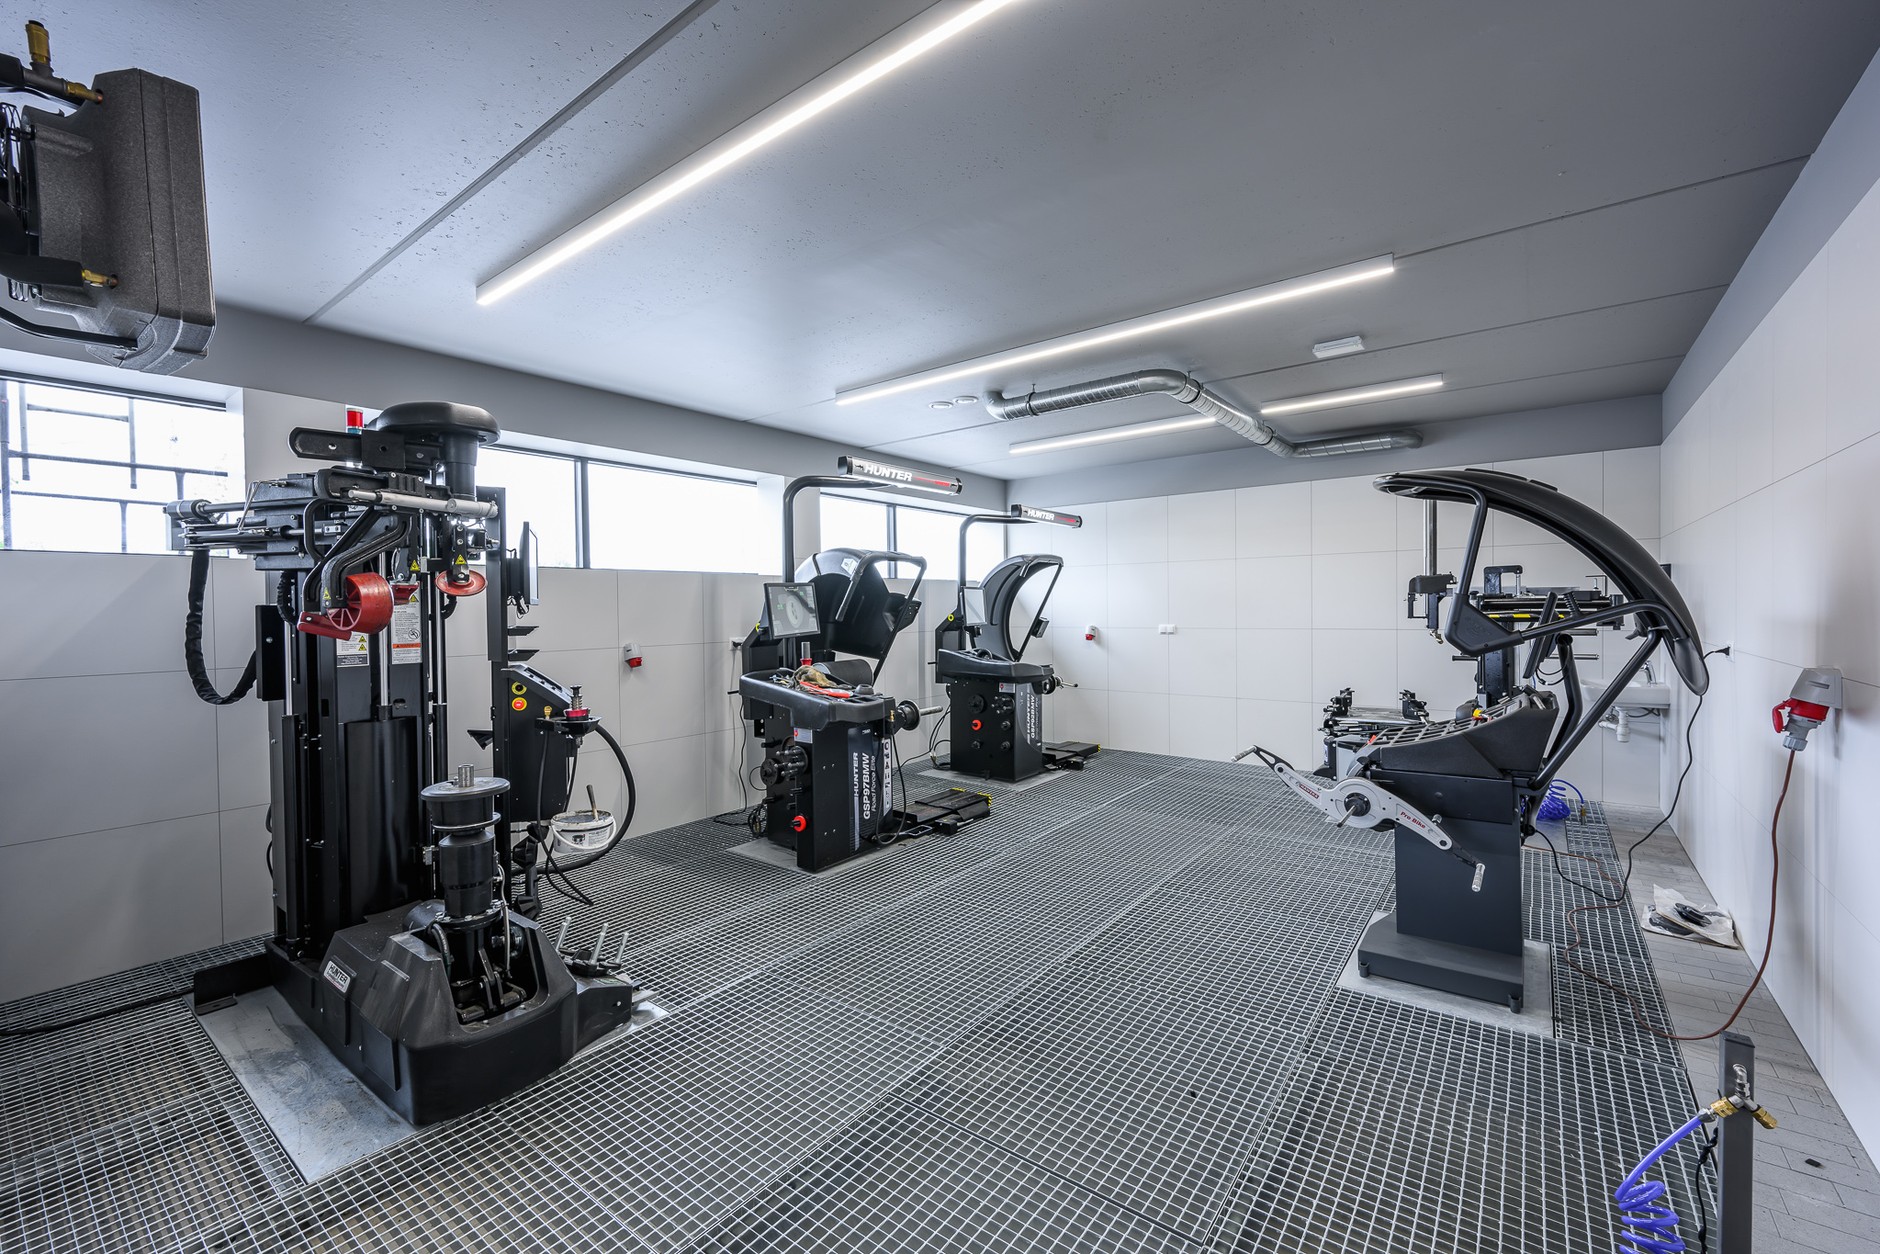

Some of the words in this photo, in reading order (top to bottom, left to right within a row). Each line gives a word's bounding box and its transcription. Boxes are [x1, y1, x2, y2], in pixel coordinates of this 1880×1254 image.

[863, 464, 913, 482] HUNTER
[1027, 509, 1055, 521] HUNTER
[862, 753, 871, 820] GSP97BMW
[1400, 811, 1411, 821] Pro
[1412, 818, 1426, 829] Bike
[328, 963, 349, 984] HUNTER
